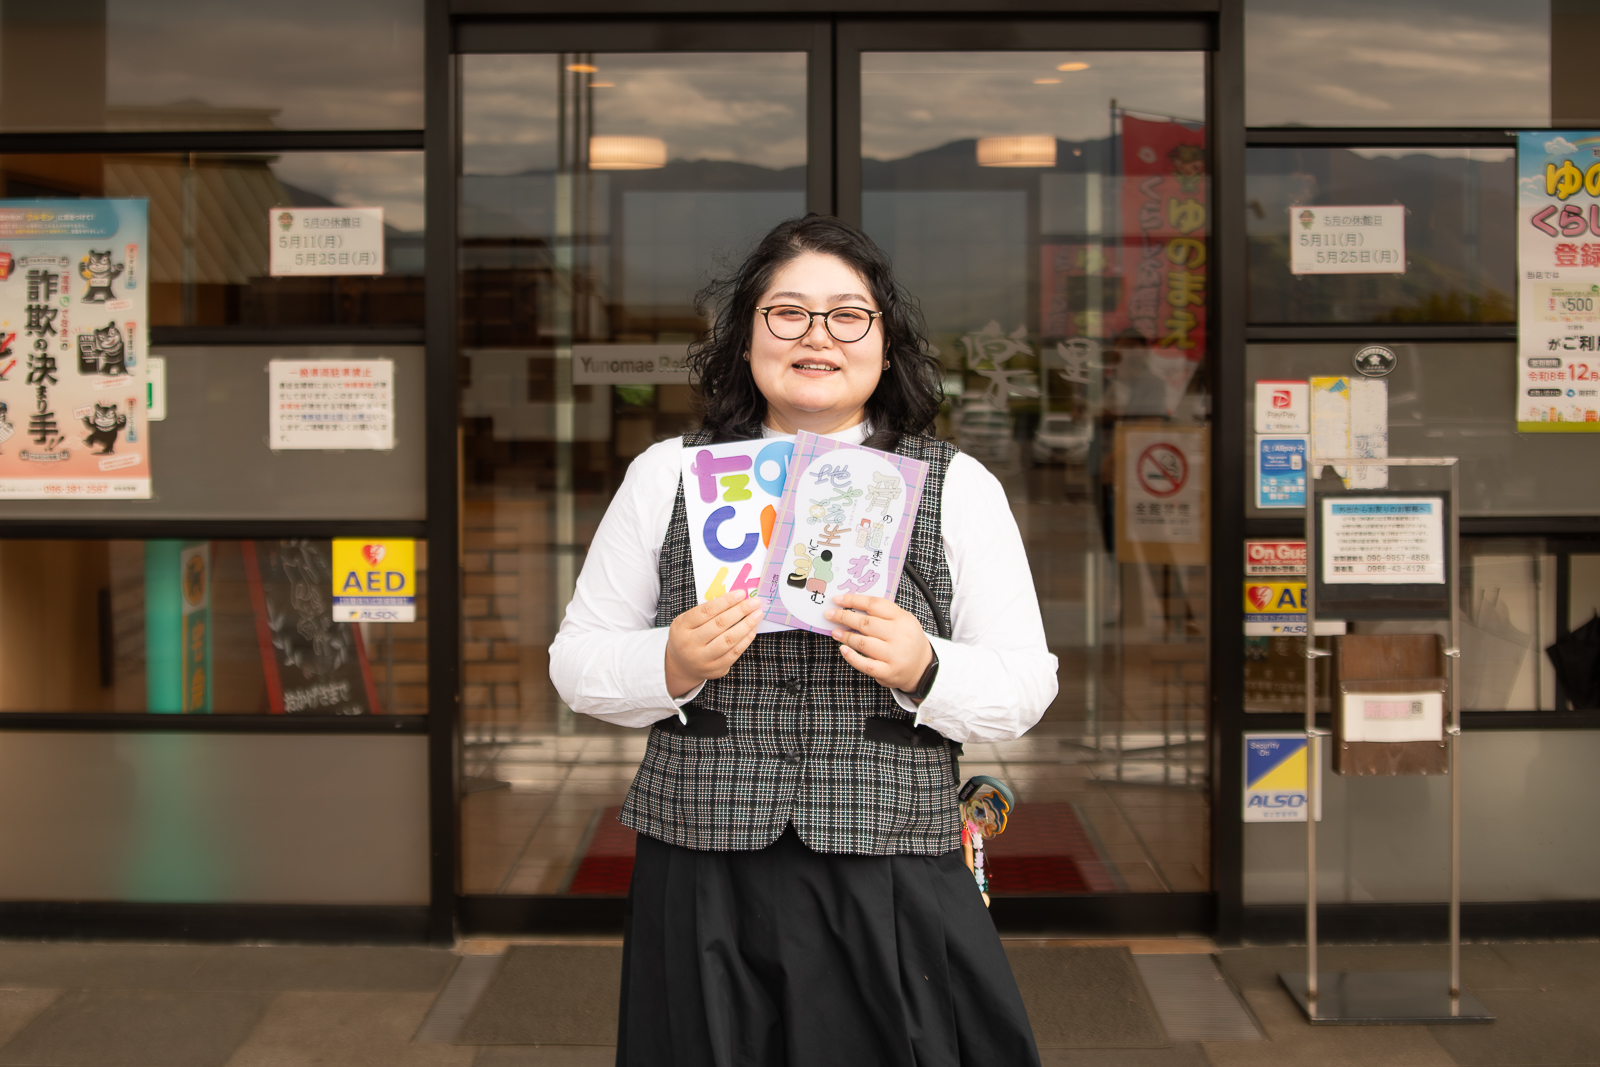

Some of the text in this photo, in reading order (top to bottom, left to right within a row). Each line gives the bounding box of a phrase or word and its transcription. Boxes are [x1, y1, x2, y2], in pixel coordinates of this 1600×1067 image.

[303, 217, 361, 228] 5月の休館日
[1324, 215, 1383, 226] 5月の休館日
[295, 252, 377, 266] 5月25日(月)
[1316, 250, 1400, 264] 5月25日(月)
[1548, 335, 1600, 351] がご利
[581, 357, 655, 374] Yunomae
[1267, 411, 1297, 420] PayPay
[1250, 546, 1307, 560] On Gua
[342, 571, 406, 593] AED
[1282, 626, 1307, 634] ALSO
[1250, 742, 1280, 750] Security
[1247, 794, 1307, 808] ALSO
